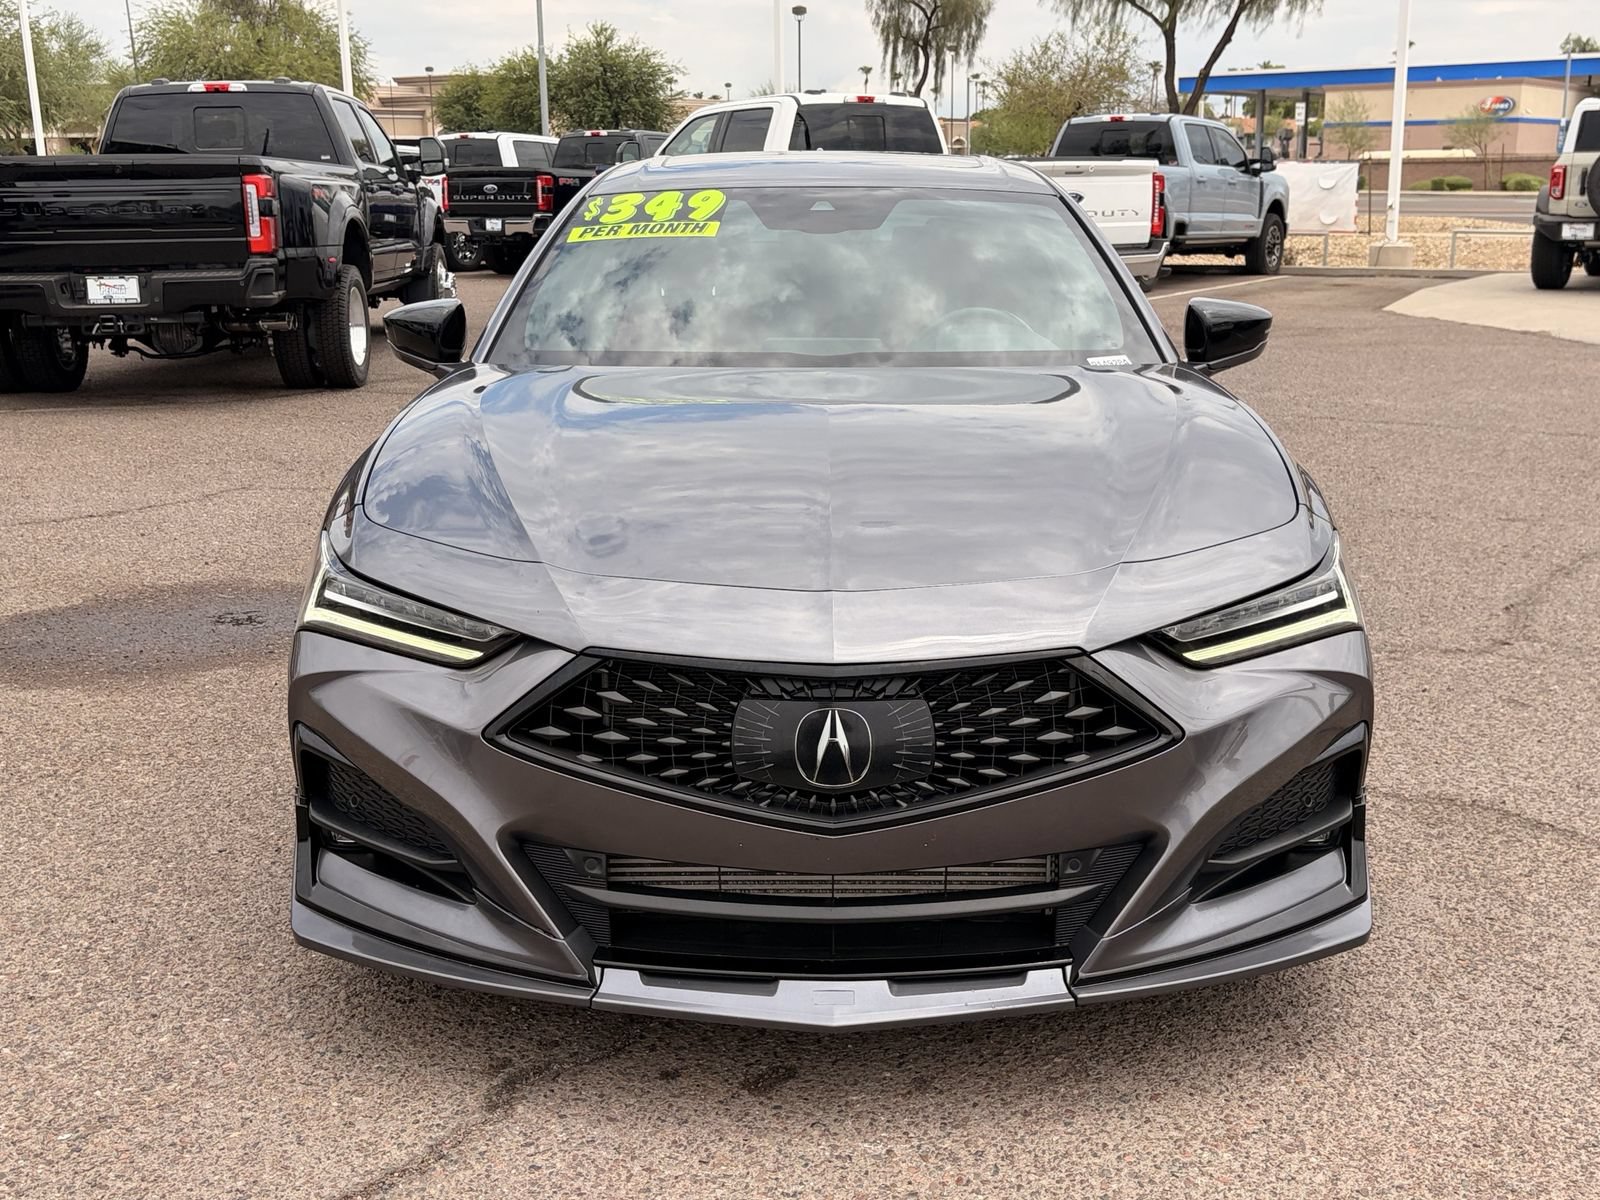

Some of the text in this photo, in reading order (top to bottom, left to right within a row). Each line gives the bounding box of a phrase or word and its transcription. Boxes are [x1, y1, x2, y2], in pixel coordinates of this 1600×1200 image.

[584, 189, 726, 224] $349
[578, 222, 708, 239] PER MONTH
